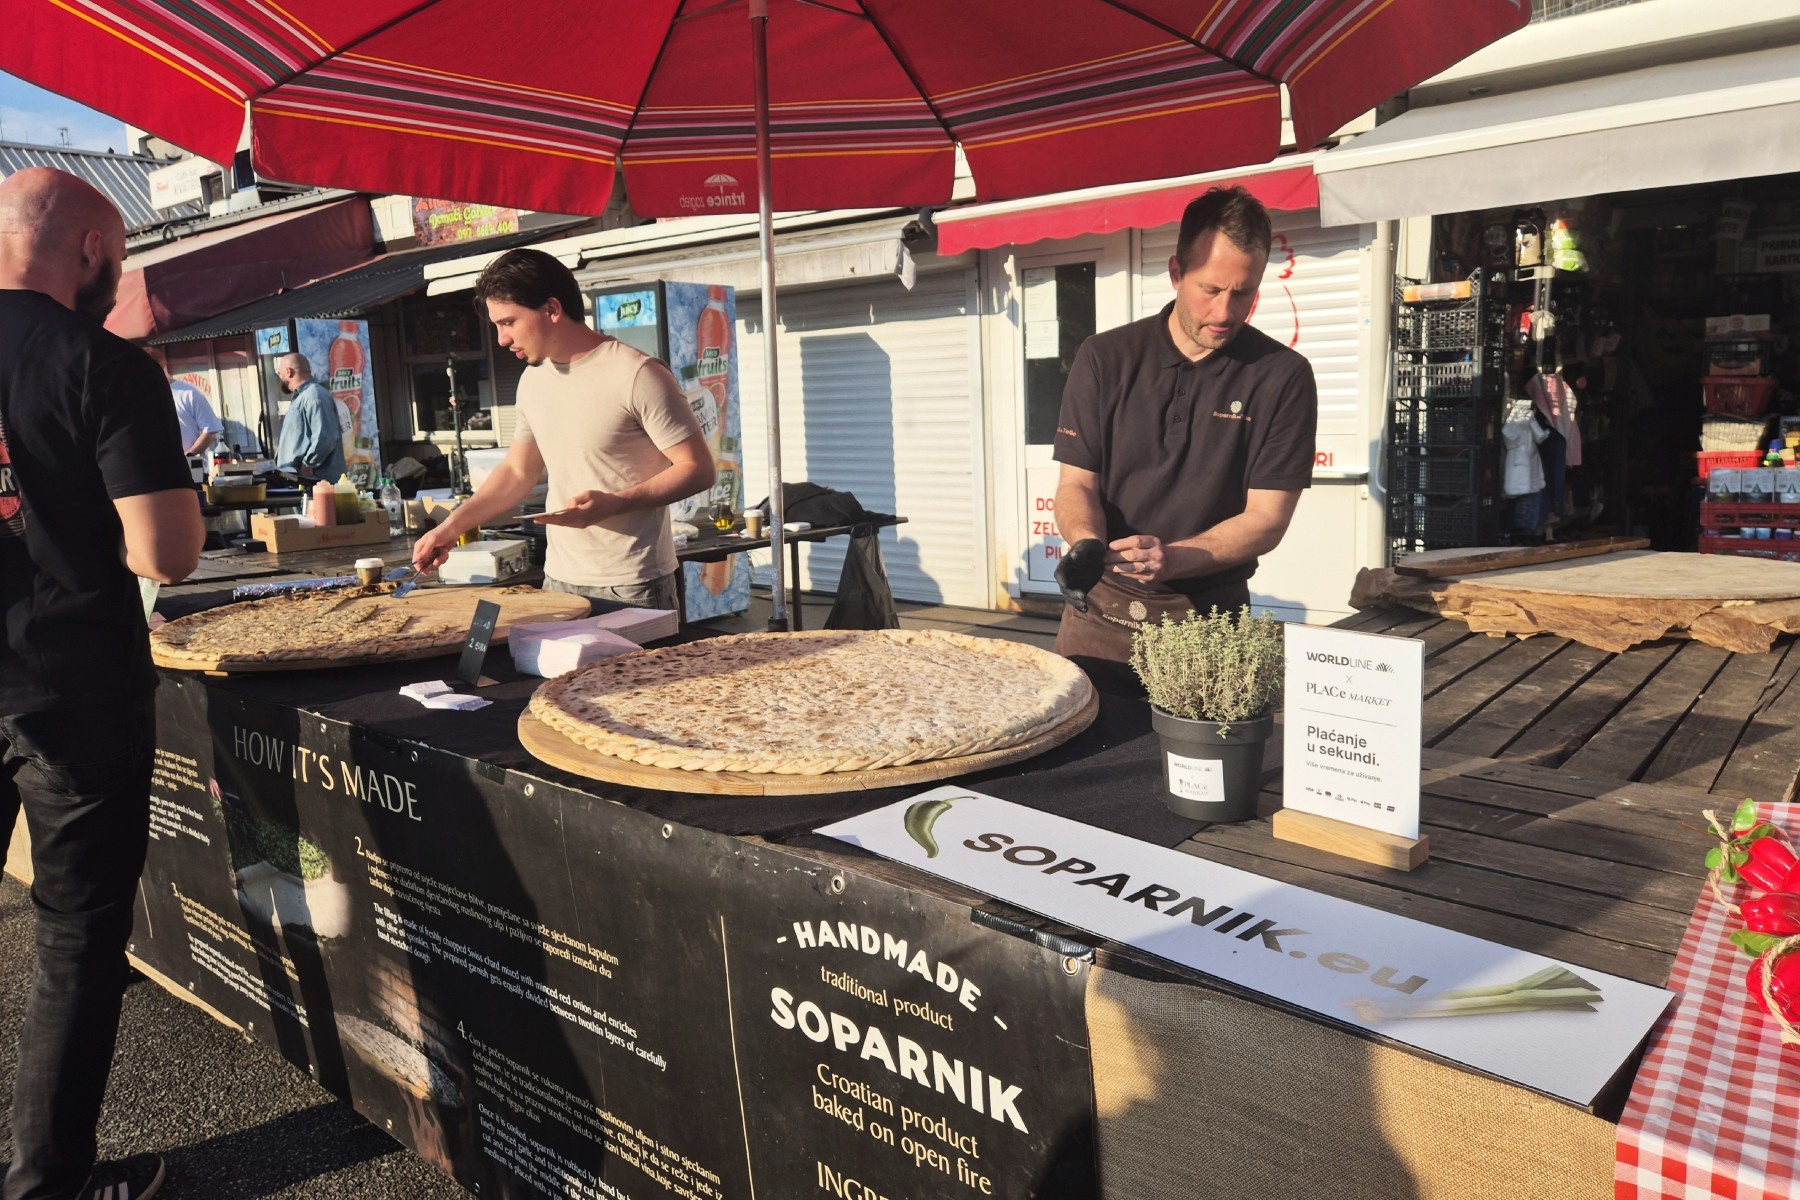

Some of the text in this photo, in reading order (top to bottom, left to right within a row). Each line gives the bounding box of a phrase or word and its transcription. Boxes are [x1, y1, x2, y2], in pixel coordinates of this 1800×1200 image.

[1761, 240, 1800, 250] PRIMA
[330, 376, 361, 391] fruits
[698, 356, 727, 377] fruits
[0, 468, 16, 492] R
[468, 638, 475, 648] 2
[1306, 652, 1372, 670] WORLDLINE
[1306, 682, 1392, 707] PLACe MARKET
[1307, 726, 1367, 748] Plaćanje
[1307, 742, 1380, 766] u sekundi.
[234, 726, 284, 773] HOW
[292, 744, 334, 790] IT'S
[340, 760, 422, 822] MADE
[1306, 760, 1318, 768] Više
[1320, 765, 1346, 774] vremena
[1355, 770, 1383, 783] uživanje.
[962, 832, 1428, 995] SOPARNIK.eu
[521, 918, 528, 927] sa
[551, 928, 586, 952] sjeckanom
[588, 942, 618, 965] kapulom
[542, 942, 570, 960] raporedi
[599, 963, 611, 979] dva
[792, 920, 981, 1012] HANDMADE
[520, 972, 533, 987] with
[534, 979, 557, 999] minced
[559, 993, 571, 1005] red
[572, 999, 591, 1016] onion
[593, 1010, 606, 1023] and
[608, 1017, 637, 1038] enriches
[821, 966, 954, 1031] traditional product
[548, 999, 576, 1023] between
[604, 1027, 625, 1047] layers
[626, 1040, 634, 1052] of
[635, 1046, 666, 1072] carefully
[771, 987, 1029, 1134] SOPARNIK
[532, 1071, 539, 1081] se
[595, 1107, 633, 1135] maslinovim
[634, 1129, 653, 1148] uljem
[655, 1139, 658, 1150] i
[659, 1143, 679, 1162] sitno
[681, 1156, 719, 1185] sjeckanim
[816, 1063, 980, 1159] Croatian product
[603, 1138, 618, 1155] stavi
[620, 1146, 639, 1168] bokal
[812, 1085, 992, 1195] baked on open fire
[617, 1130, 640, 1157] Običaj
[641, 1145, 648, 1160] je
[650, 1151, 658, 1166] da
[660, 1161, 668, 1172] se
[671, 1167, 688, 1183] reže
[690, 1174, 693, 1186] i
[695, 1177, 712, 1197] jede
[817, 1161, 889, 1200] ING
[583, 1184, 594, 1197] cut
[588, 1170, 596, 1187] by
[598, 1177, 614, 1196] hand
